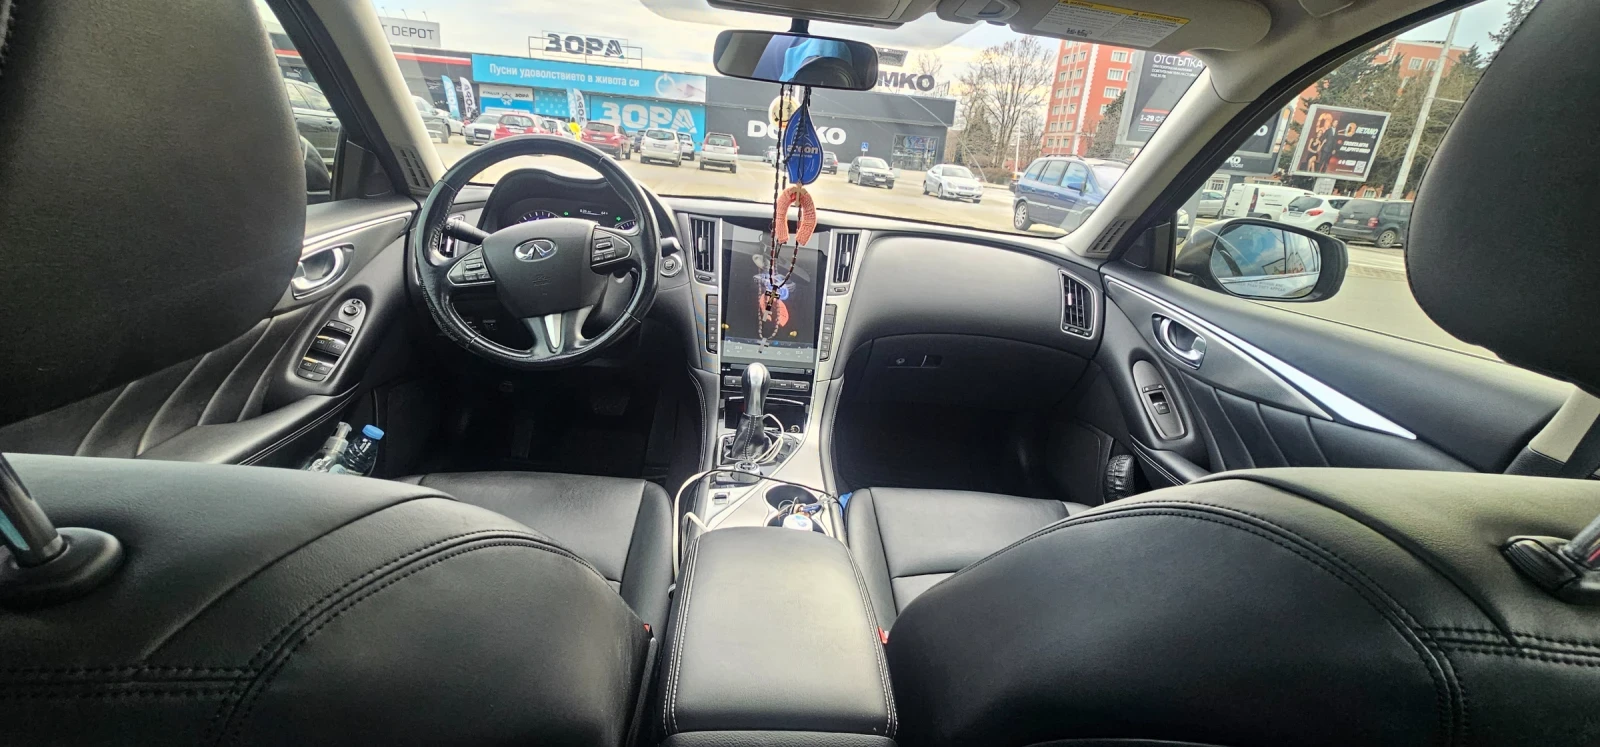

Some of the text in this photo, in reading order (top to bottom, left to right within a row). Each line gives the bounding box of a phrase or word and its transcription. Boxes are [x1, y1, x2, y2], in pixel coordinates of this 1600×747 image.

[391, 25, 434, 40] DEPOT
[544, 33, 625, 59] ЗОРА
[1153, 54, 1203, 68] ОТСТЪПКА
[489, 63, 640, 87] Пусни удоволствието в живота си
[601, 101, 698, 134] ЗОРА
